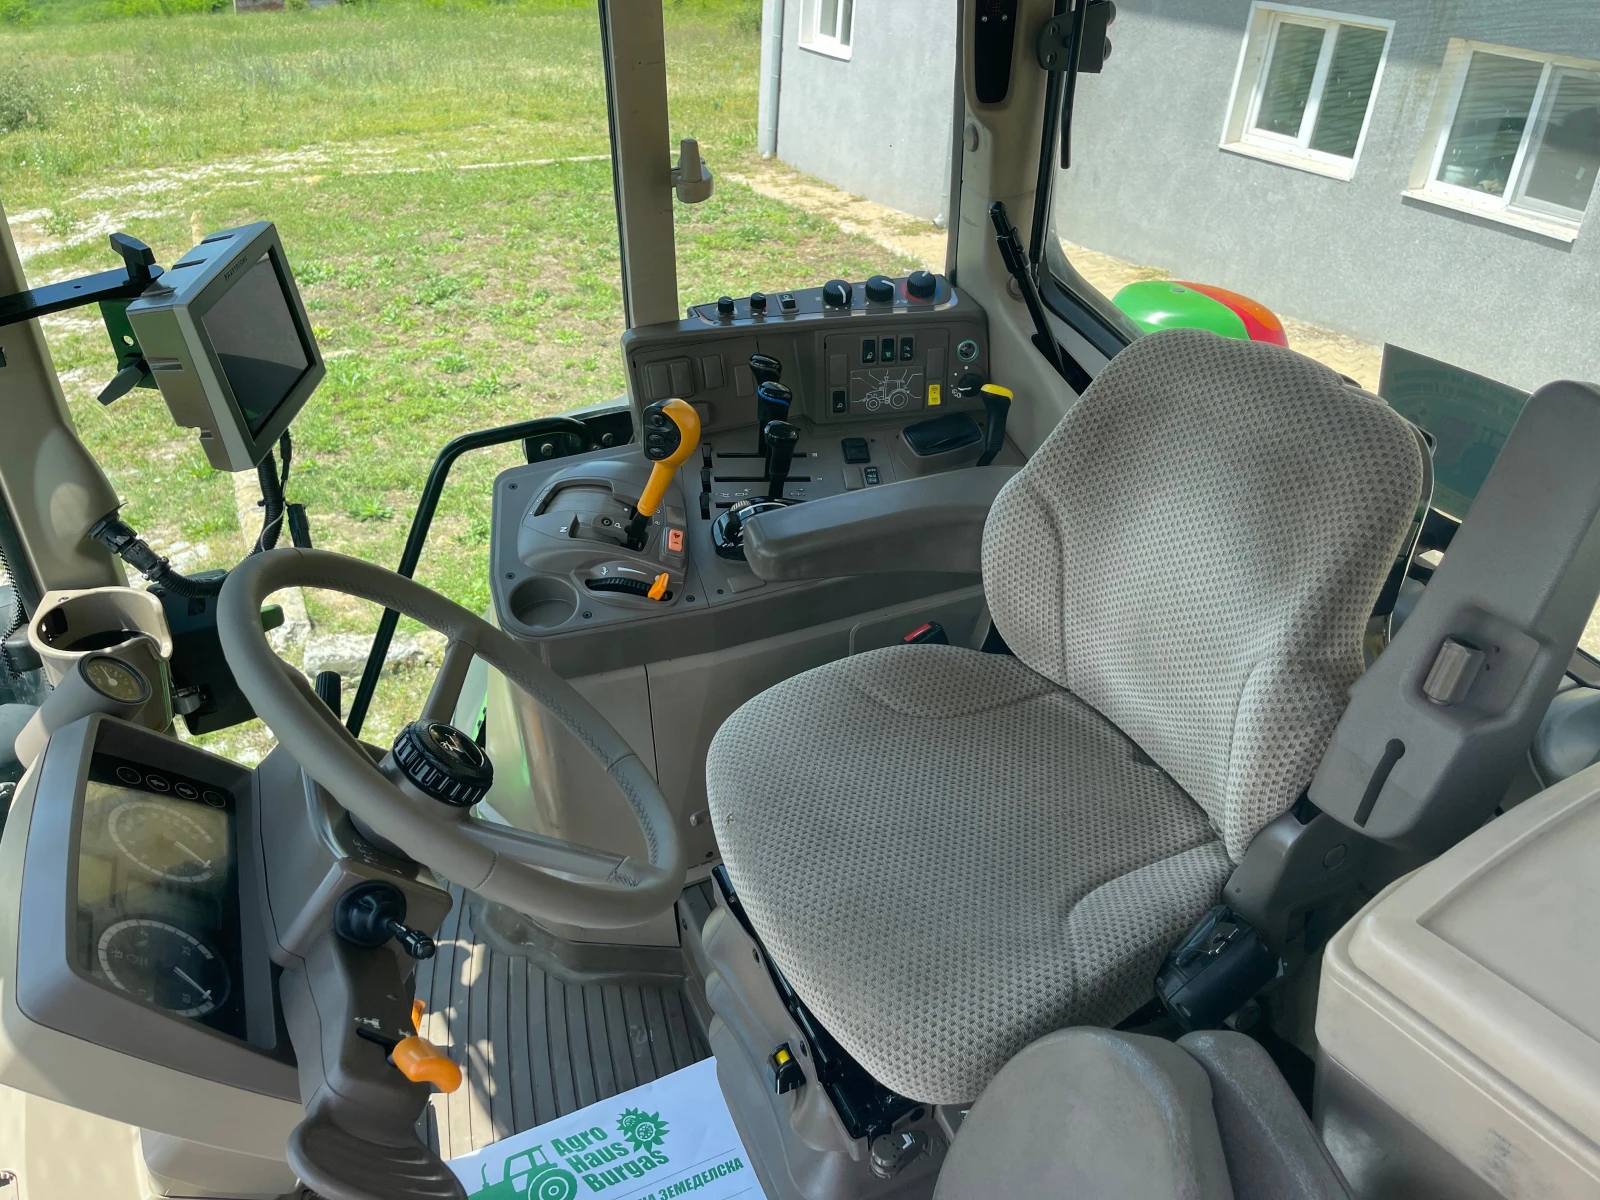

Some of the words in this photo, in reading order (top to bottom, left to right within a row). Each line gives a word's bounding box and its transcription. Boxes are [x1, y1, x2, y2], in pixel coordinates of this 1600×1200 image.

[550, 1126, 608, 1157] Agro
[565, 1142, 630, 1174] Haus
[581, 1150, 670, 1193] Burgas
[658, 1157, 744, 1200] ЗЕМЕДЕЛСКА
